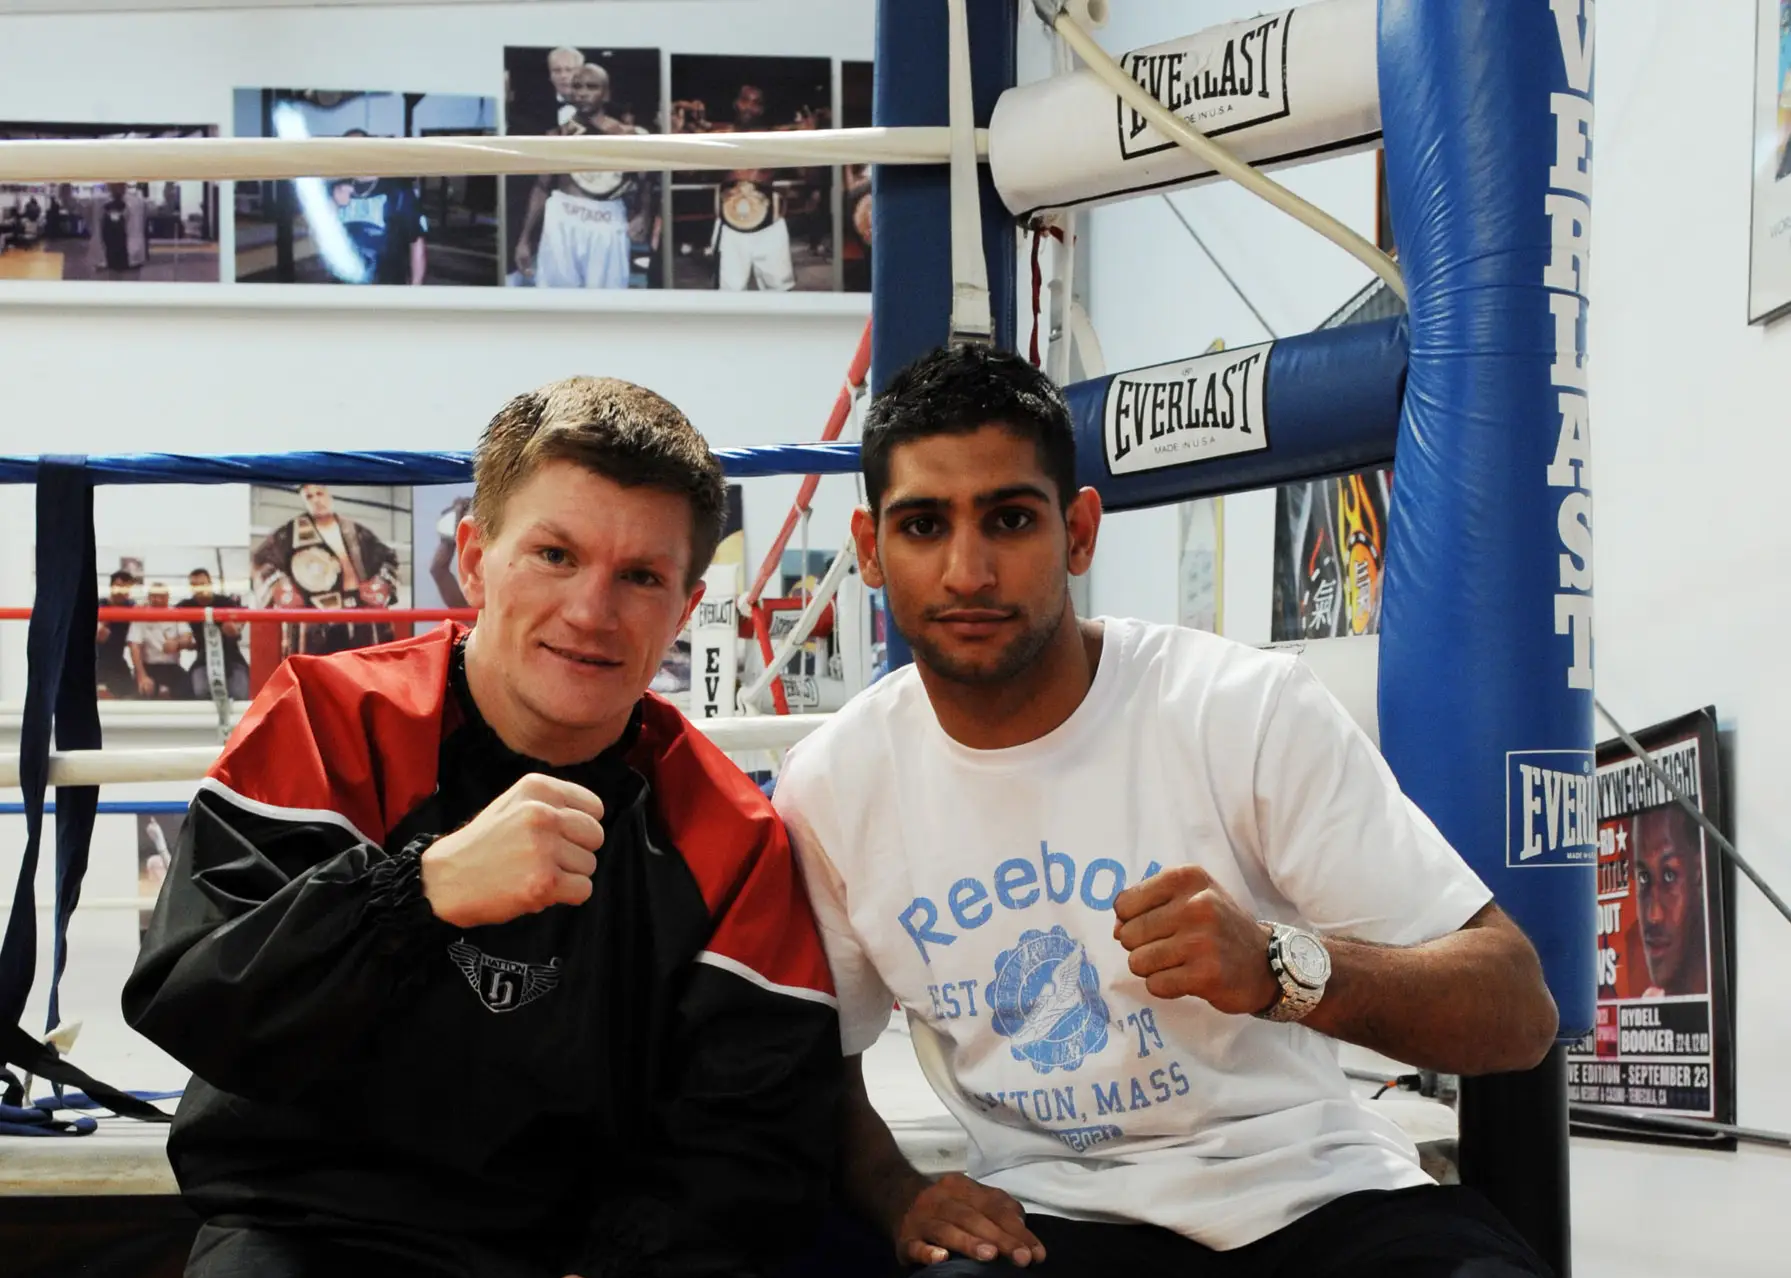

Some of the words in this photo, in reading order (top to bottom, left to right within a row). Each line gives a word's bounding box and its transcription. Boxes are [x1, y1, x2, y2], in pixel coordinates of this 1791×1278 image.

[1115, 353, 1260, 461] EVERLAST
[1154, 443, 1180, 454] MADE
[927, 979, 978, 1020] EST
[1117, 1008, 1164, 1058] '79
[1621, 1008, 1661, 1027] RYDELL
[1621, 1029, 1674, 1053] BOOKER
[1091, 1061, 1190, 1116] MASS
[1582, 1064, 1620, 1084] EDITION
[1628, 1065, 1691, 1088] SEPTEMBER
[1694, 1067, 1708, 1088] 23
